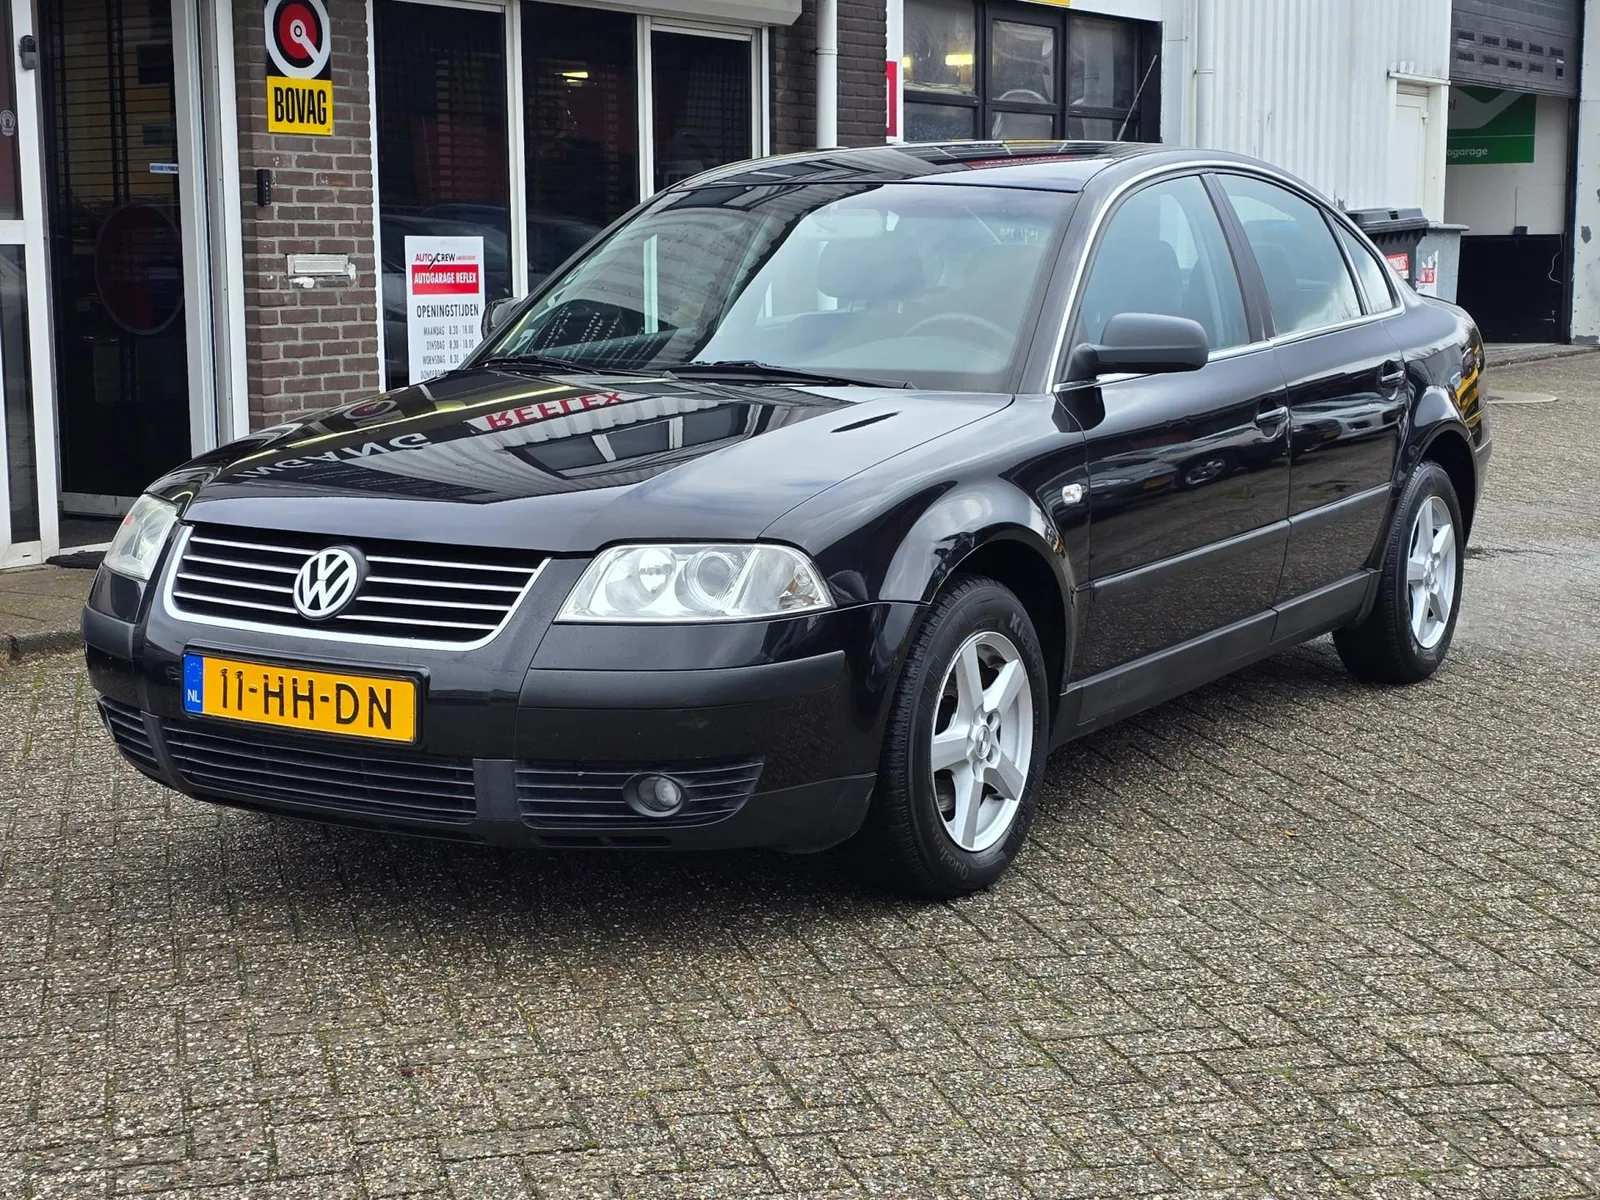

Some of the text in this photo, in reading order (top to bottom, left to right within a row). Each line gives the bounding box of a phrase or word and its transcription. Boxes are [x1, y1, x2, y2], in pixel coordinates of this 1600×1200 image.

[274, 86, 328, 125] BOVAG
[414, 272, 477, 284] AUTOGARAGE REFLEX
[416, 304, 479, 318] OPENINGSTIJDEN
[423, 325, 445, 336] MAANDAG
[462, 324, 474, 335] 18.00
[426, 340, 445, 351] DINSDAG
[462, 339, 474, 349] 18.00
[422, 354, 446, 366] WOENSDAG
[187, 688, 201, 703] NL
[220, 668, 392, 729] 11-HH-DN
